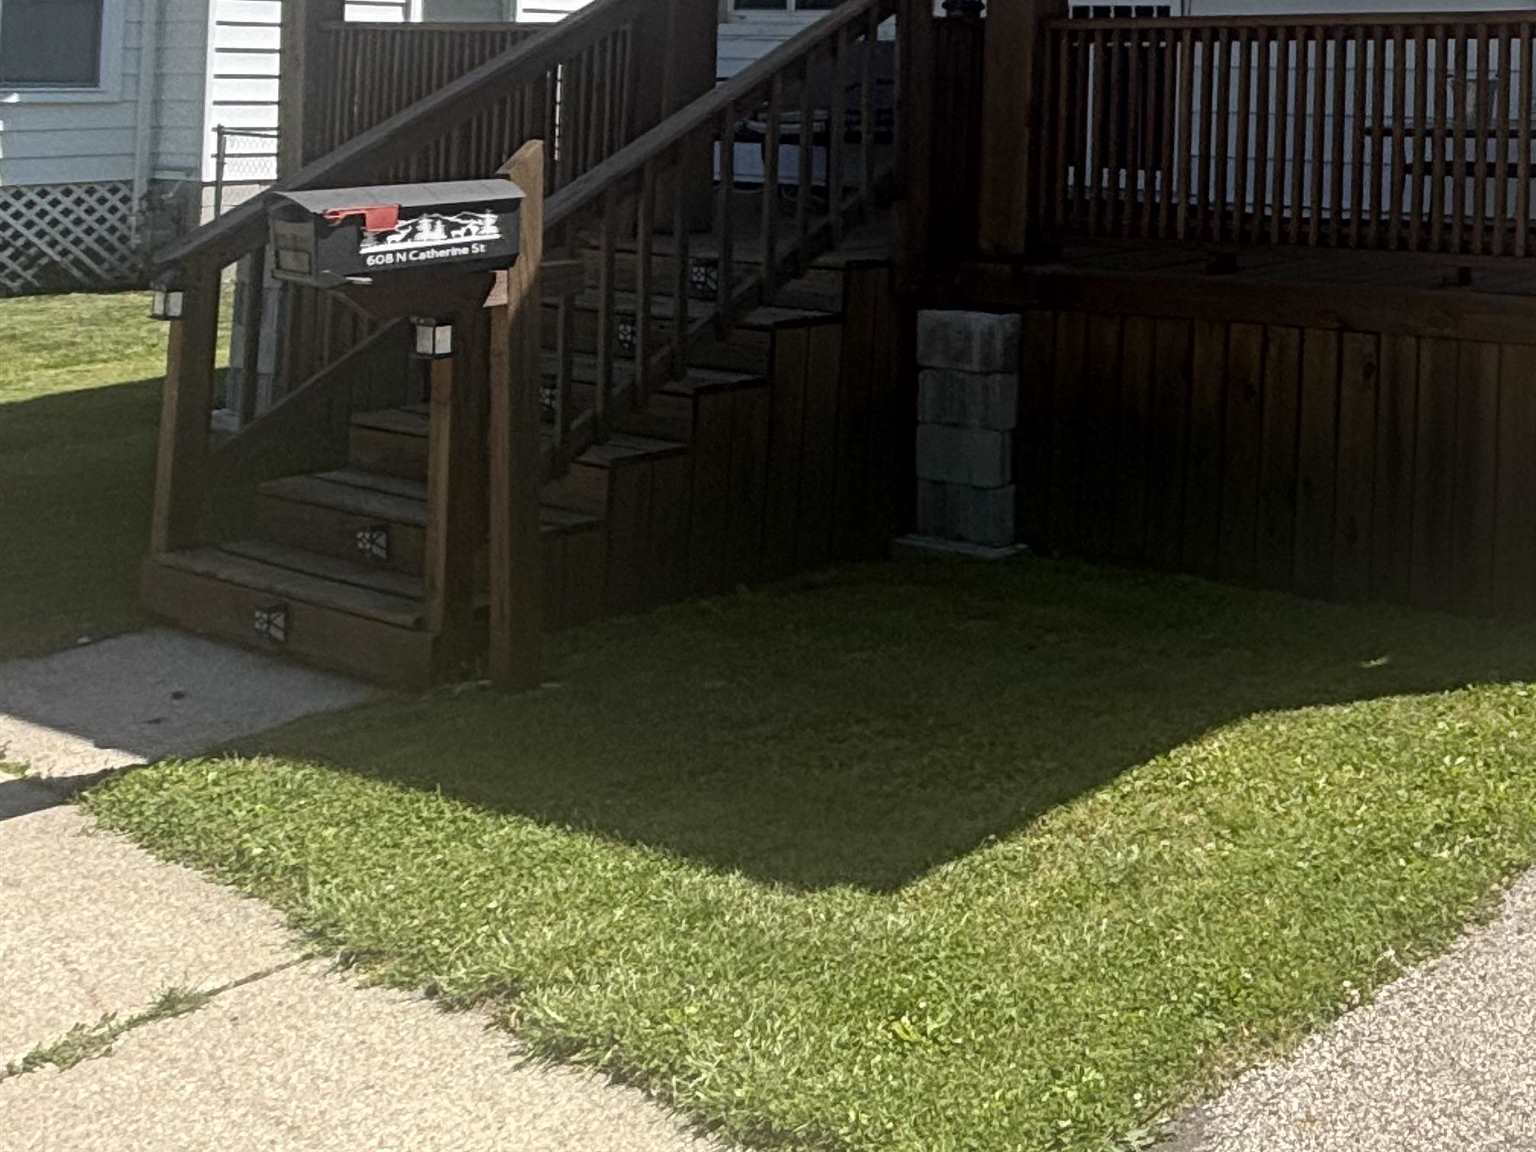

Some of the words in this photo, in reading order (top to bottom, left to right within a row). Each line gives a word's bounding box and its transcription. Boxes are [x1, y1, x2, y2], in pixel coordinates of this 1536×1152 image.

[366, 253, 394, 266] 608
[396, 251, 407, 262] N
[409, 247, 469, 260] Catherine
[471, 243, 487, 253] St
